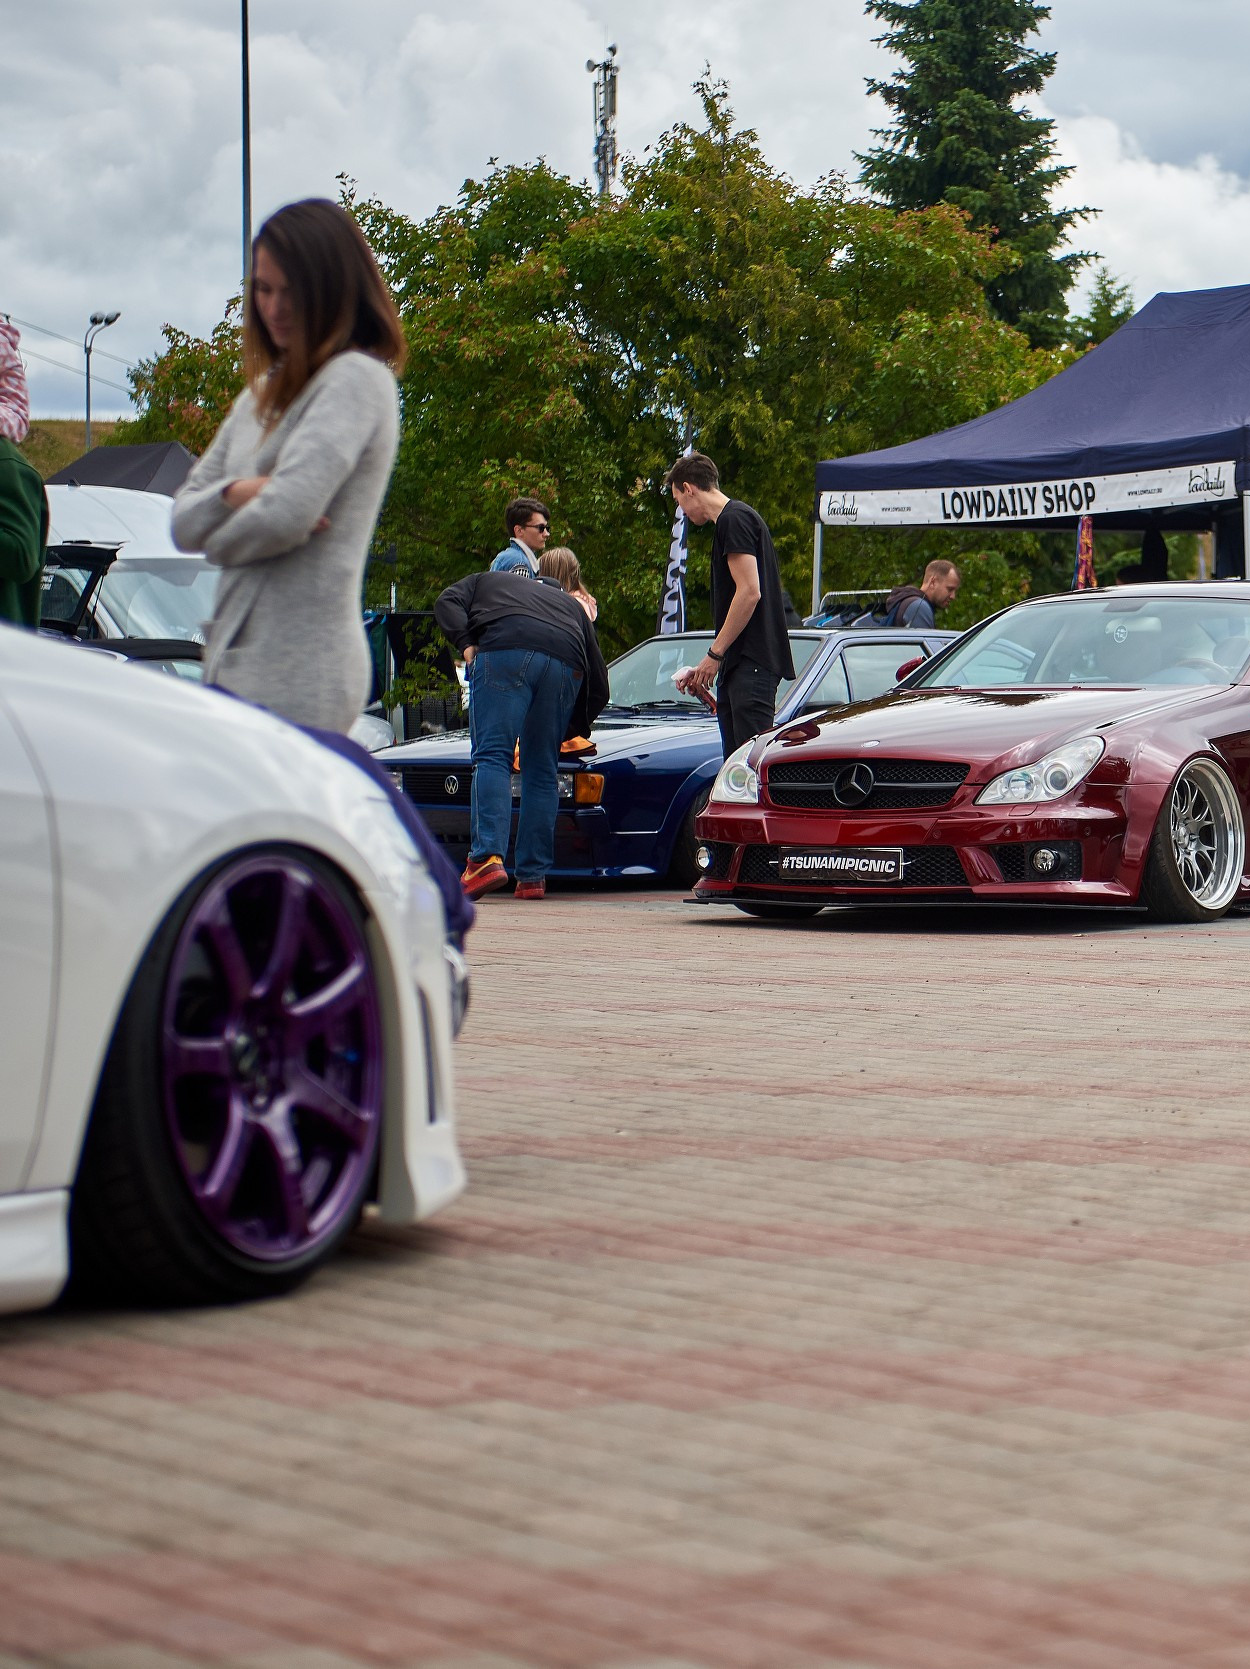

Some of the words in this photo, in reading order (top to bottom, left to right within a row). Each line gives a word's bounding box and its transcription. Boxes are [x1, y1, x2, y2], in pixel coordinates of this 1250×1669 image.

[940, 487, 1037, 520] LOWDAILY
[1042, 482, 1096, 514] SHOP
[782, 856, 896, 873] #TSUNAMIPICNIC
